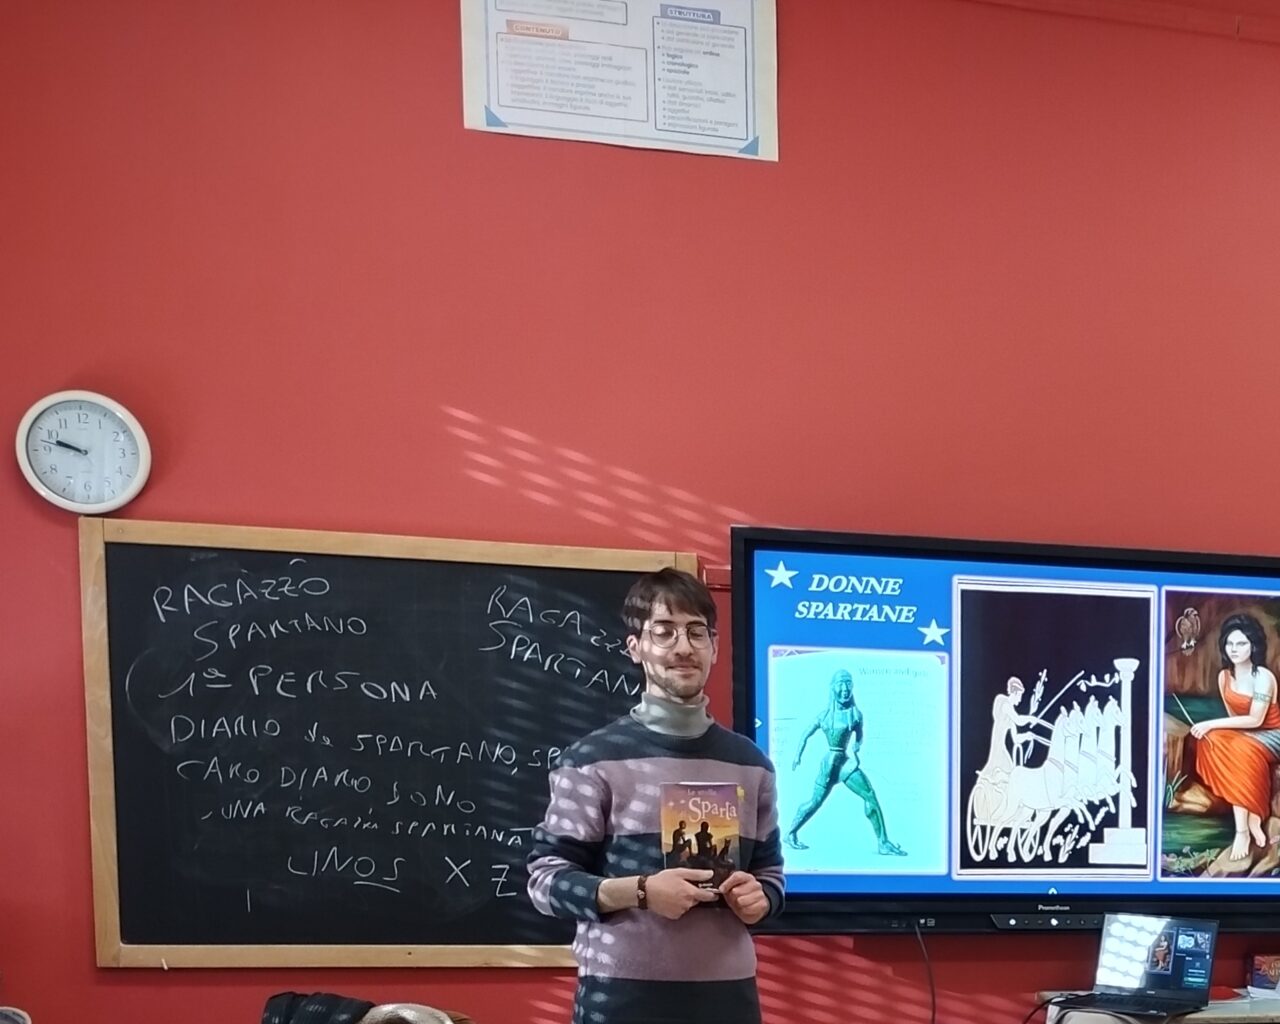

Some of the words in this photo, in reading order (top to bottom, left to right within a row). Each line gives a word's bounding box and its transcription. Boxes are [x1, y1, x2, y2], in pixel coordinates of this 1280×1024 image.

[58, 418, 68, 429] 11
[77, 412, 89, 425] 12
[47, 429, 59, 440] 10
[112, 431, 121, 442] 2
[119, 448, 126, 459] 3
[49, 464, 58, 474] 8
[83, 481, 92, 492] 6
[808, 574, 904, 596] DONNE
[487, 584, 632, 658] RAGAZZ
[794, 601, 918, 624] SPARTANE
[478, 620, 641, 696] SPARTAN
[250, 665, 438, 702] PERSONA
[171, 714, 282, 744] DIARIO
[280, 765, 371, 793] DIARIO
[688, 797, 738, 823] Sparta
